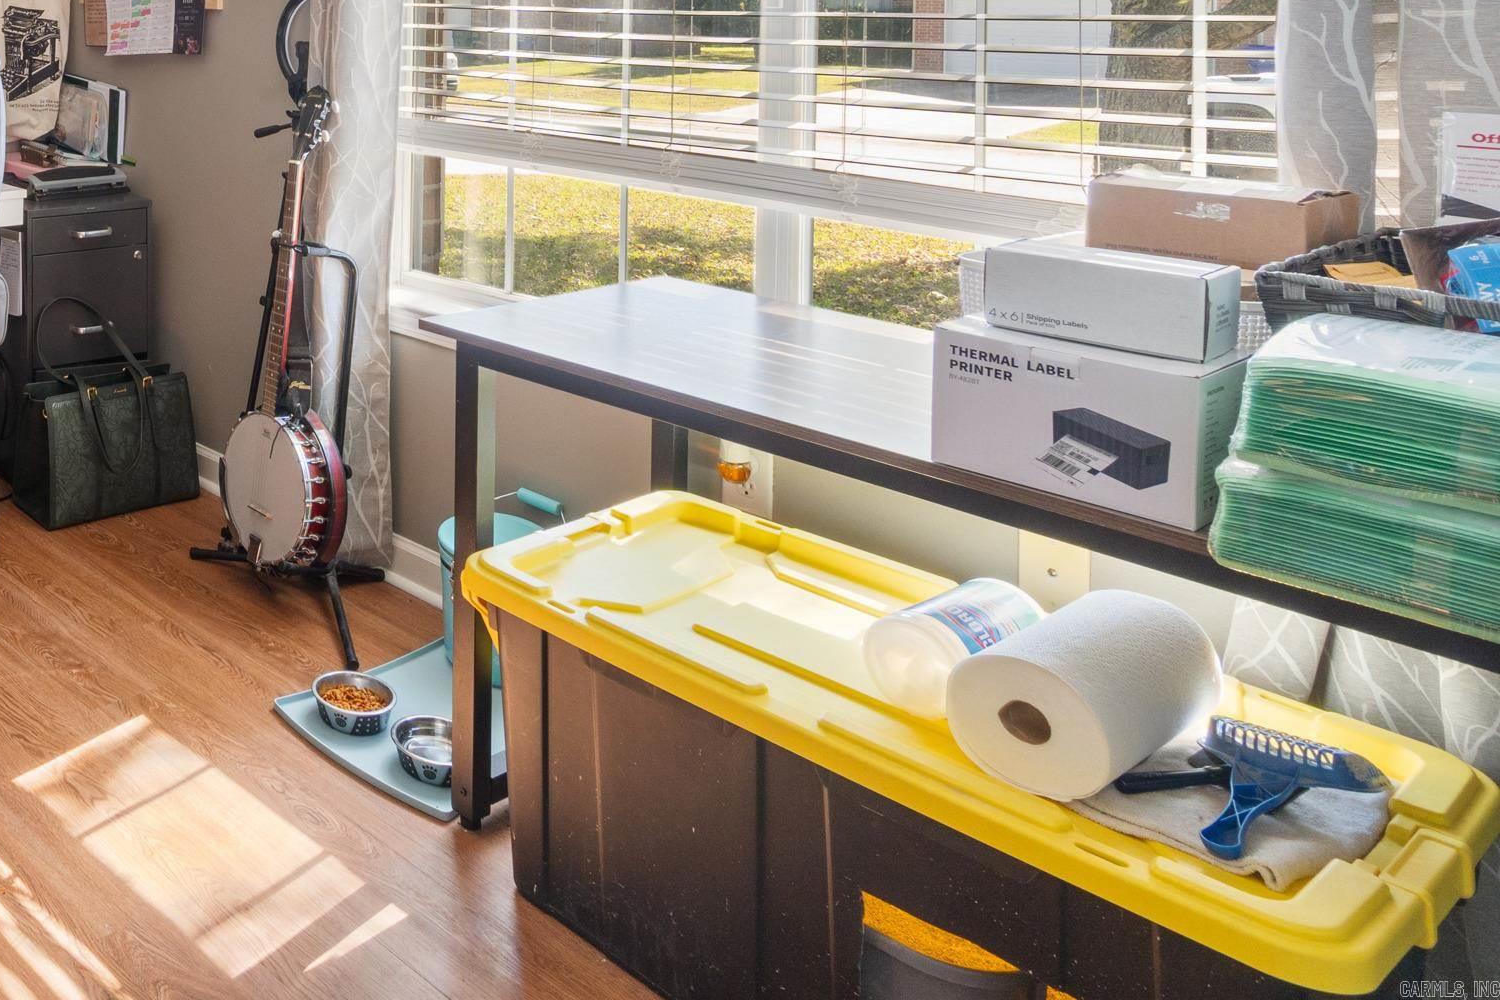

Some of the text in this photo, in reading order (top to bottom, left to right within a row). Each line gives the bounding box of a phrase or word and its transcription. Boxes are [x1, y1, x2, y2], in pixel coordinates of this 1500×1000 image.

[988, 307, 1019, 321] 4 x 6
[1026, 313, 1089, 330] Shipping Labels
[949, 344, 1075, 380] THERMAL LABEL
[949, 359, 1013, 383] PRINTER
